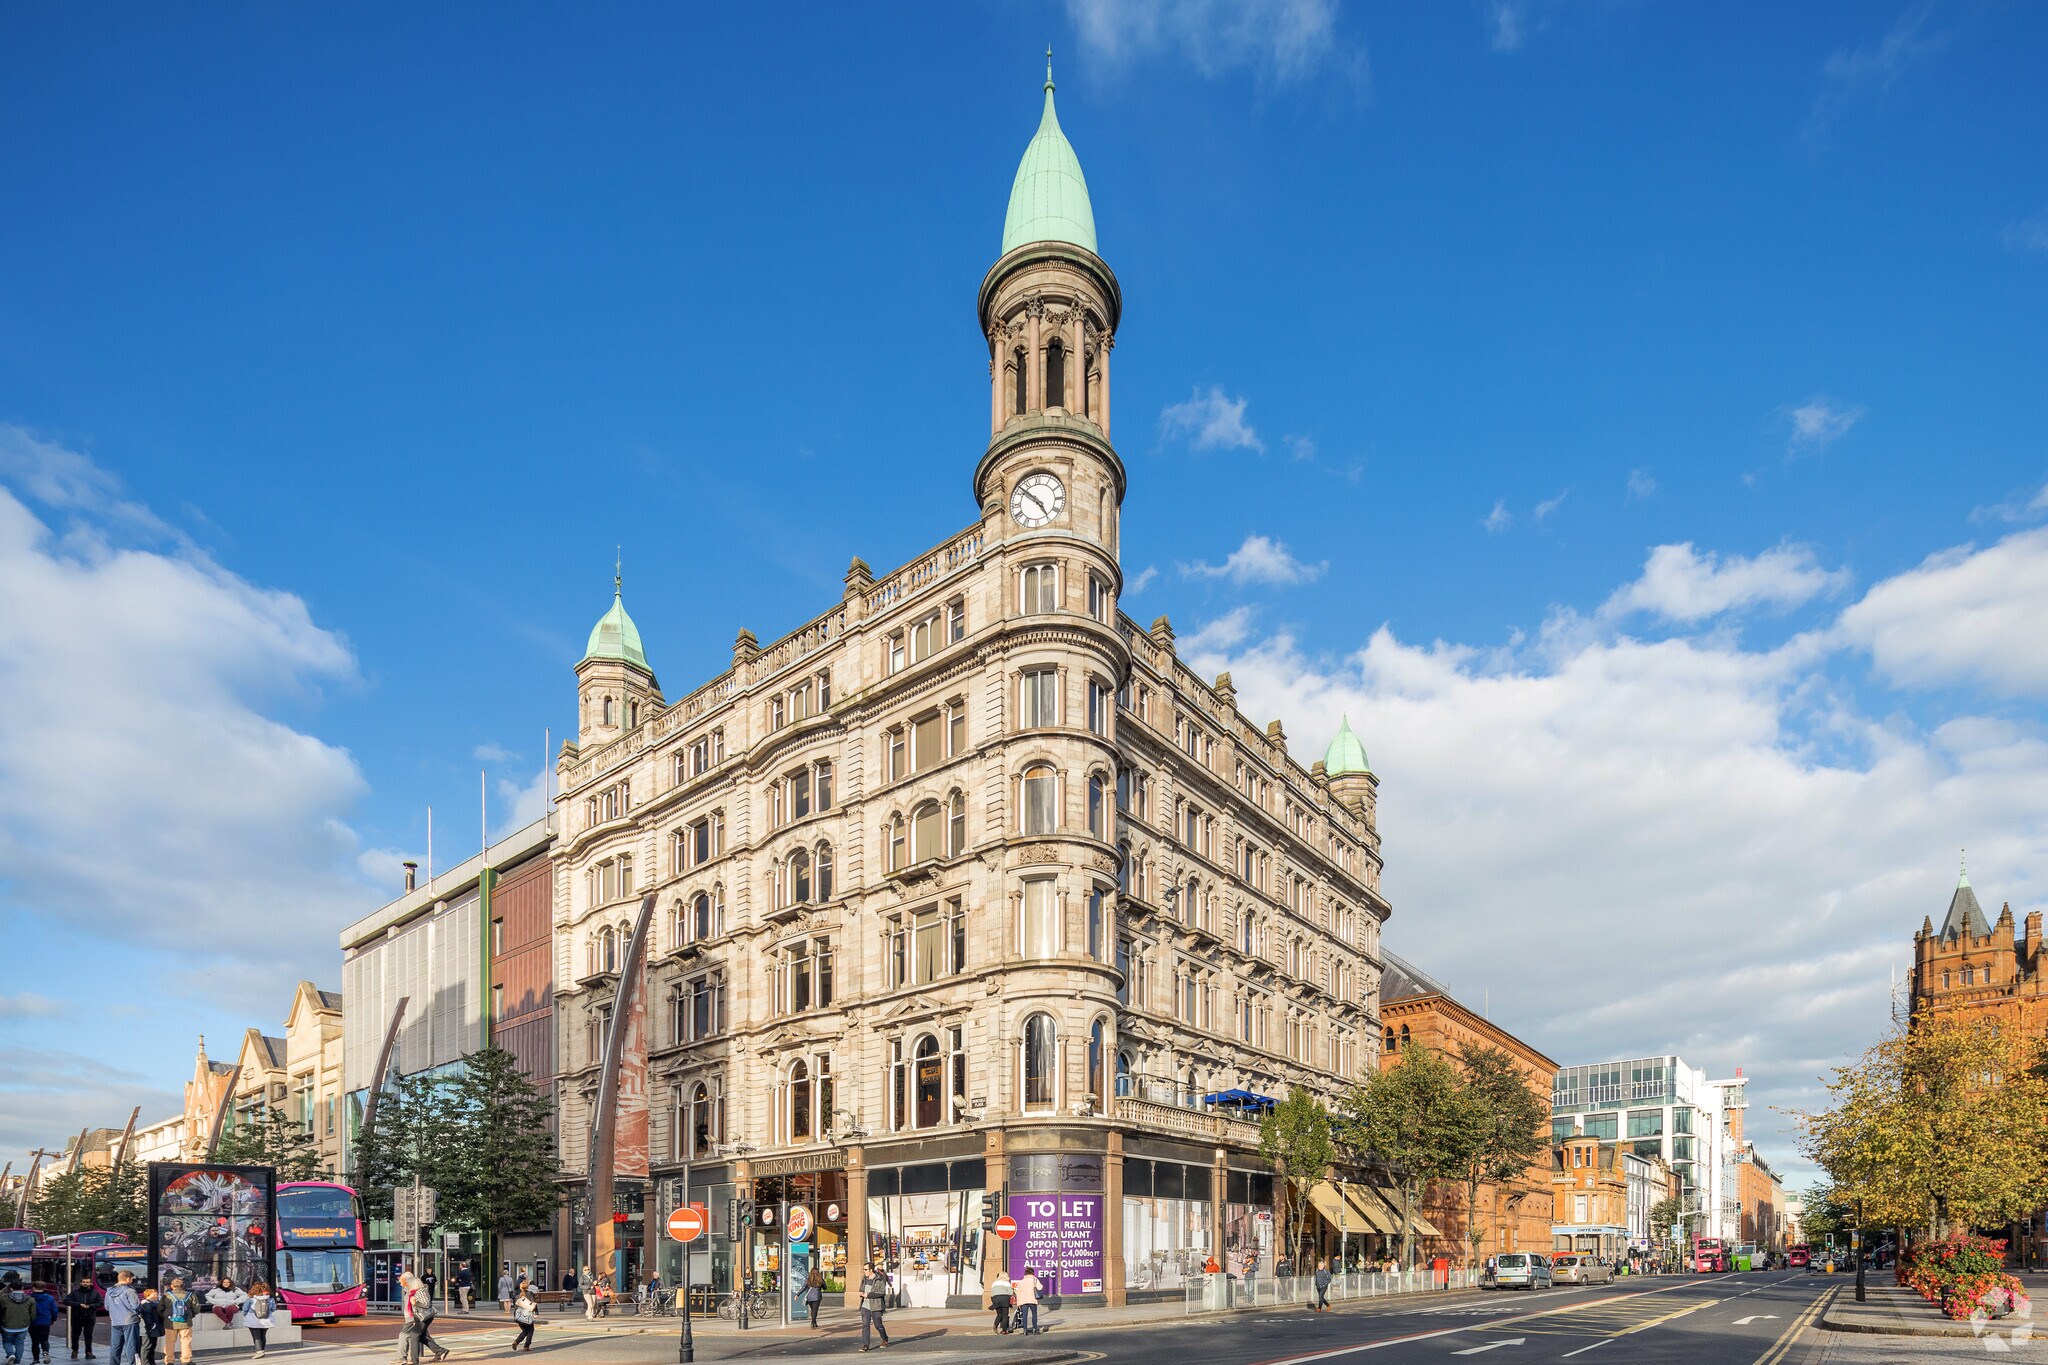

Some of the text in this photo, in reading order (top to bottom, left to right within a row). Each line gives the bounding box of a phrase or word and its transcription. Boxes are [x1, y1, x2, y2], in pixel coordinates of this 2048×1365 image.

[754, 1159, 793, 1176] ROBINSON
[795, 1160, 801, 1172] &
[802, 1153, 842, 1171] CLEAVER
[1027, 1201, 1094, 1217] TO LET
[788, 1218, 805, 1232] KING
[1027, 1221, 1055, 1229] PRIME
[1025, 1249, 1054, 1259] (STPP)
[1024, 1260, 1041, 1268] ALL
[1038, 1270, 1079, 1278] EPC D82
